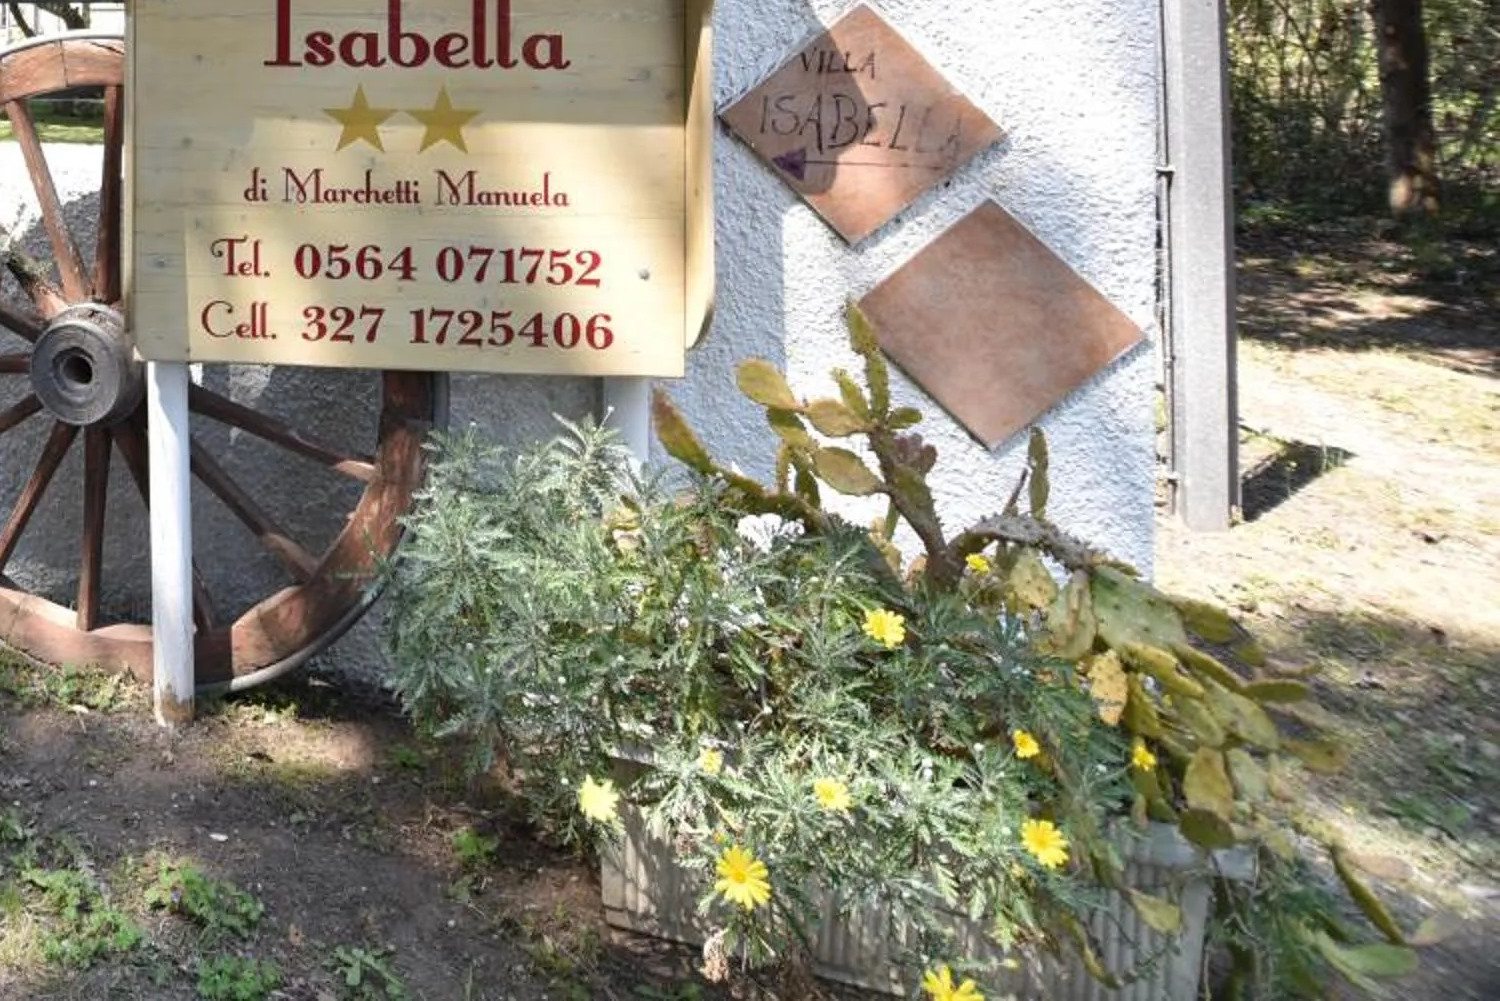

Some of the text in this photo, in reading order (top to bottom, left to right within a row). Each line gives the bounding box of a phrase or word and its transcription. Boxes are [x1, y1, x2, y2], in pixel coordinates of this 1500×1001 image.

[800, 49, 876, 80] VILLA
[758, 93, 963, 158] ISABELLA
[243, 168, 570, 208] di Marchetti Manuela
[210, 237, 603, 289] Tel. 0564 071752
[201, 300, 615, 351] Cell. 327 1725406
